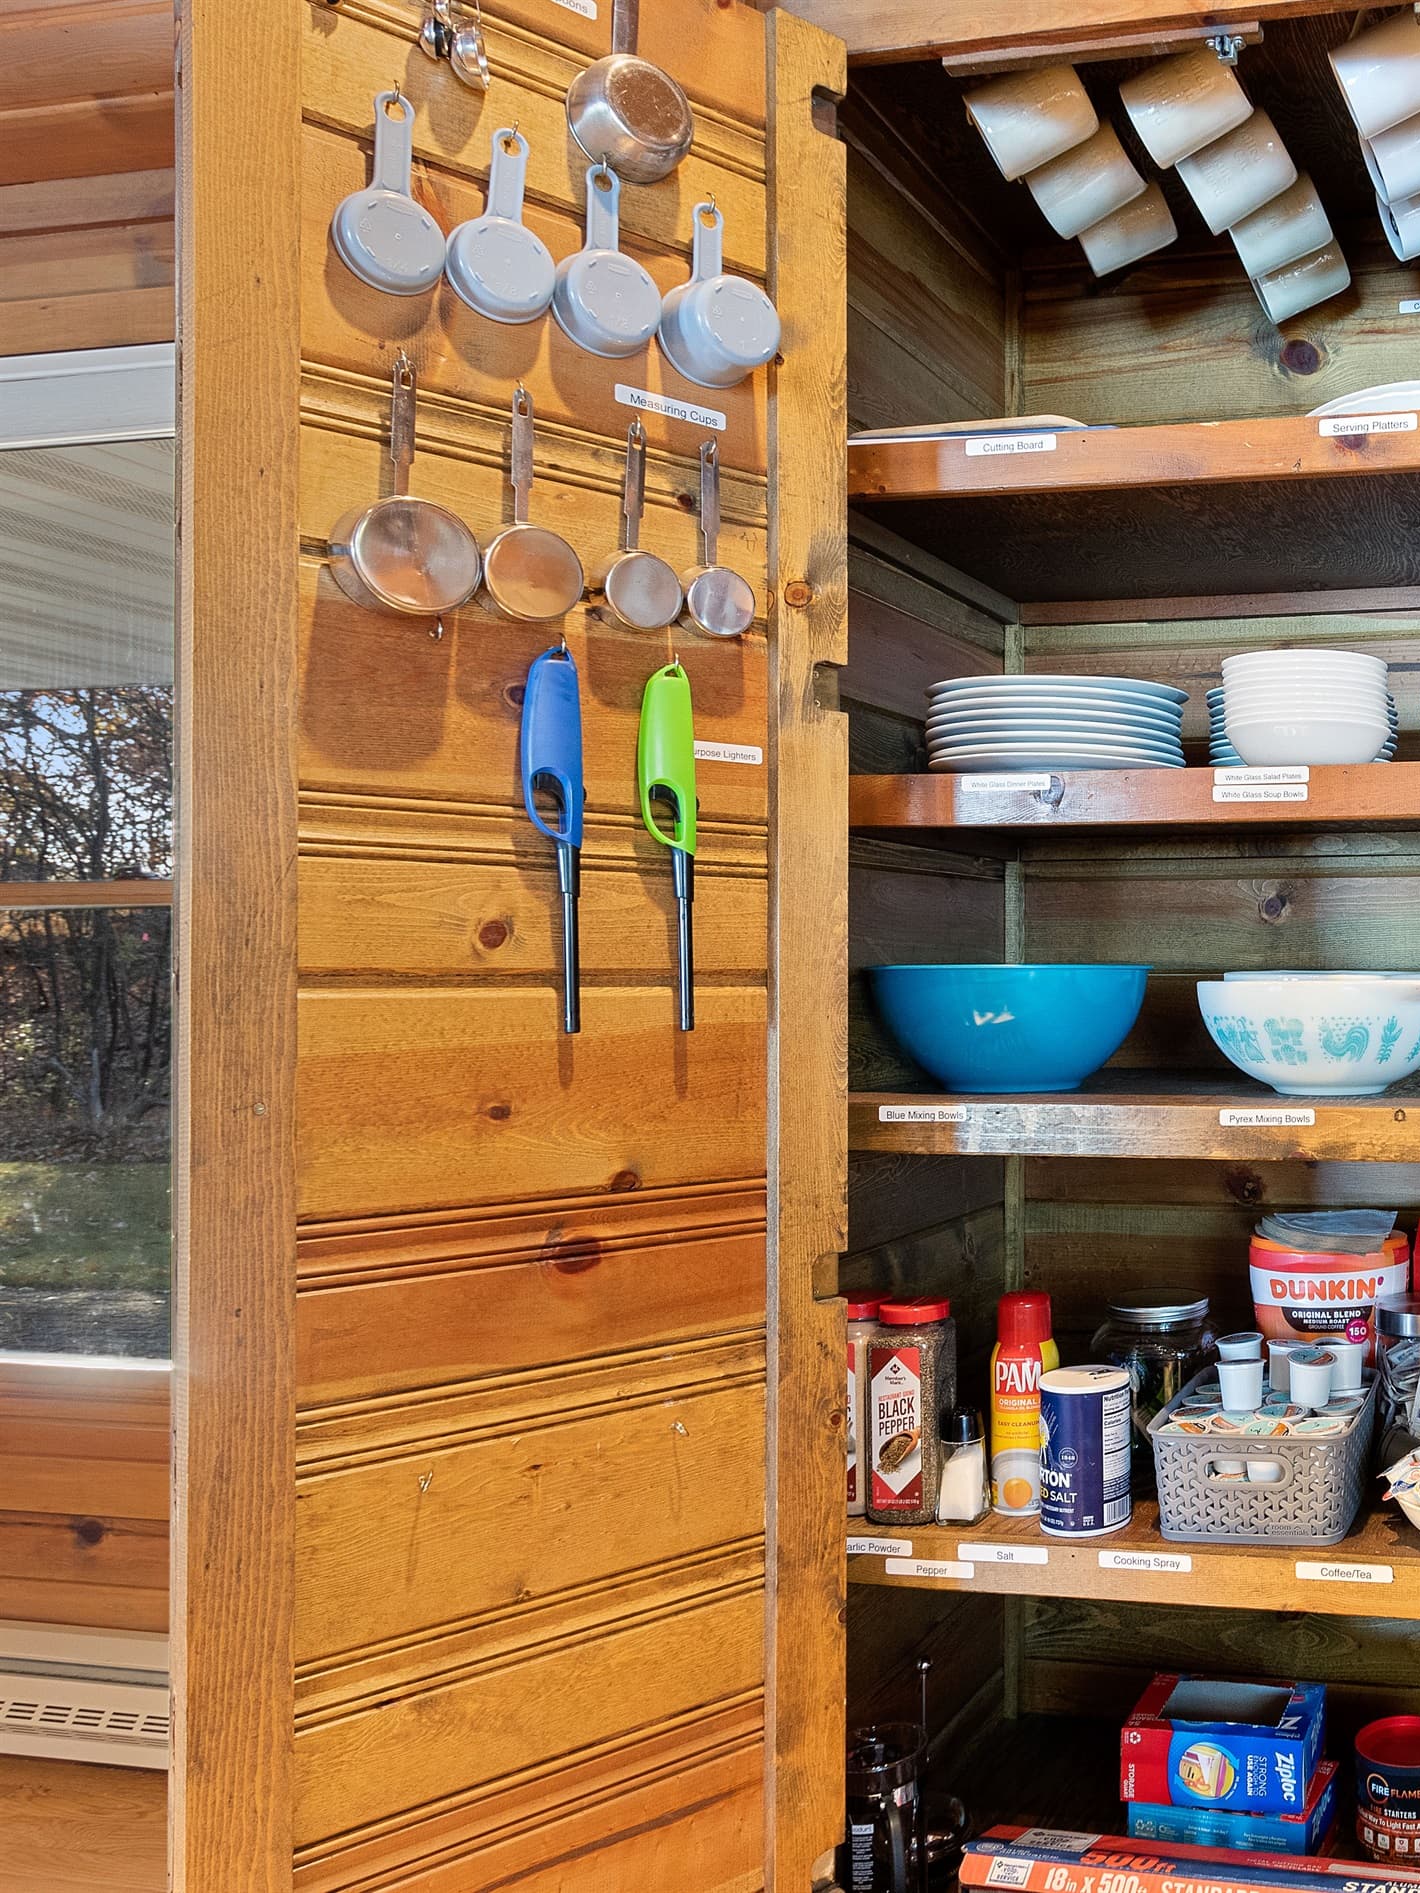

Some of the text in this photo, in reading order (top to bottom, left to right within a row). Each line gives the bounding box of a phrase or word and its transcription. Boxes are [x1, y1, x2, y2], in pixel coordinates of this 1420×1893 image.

[630, 393, 718, 427] Measuring Cups
[1332, 418, 1410, 436] Serving Platters
[982, 439, 1045, 455] Cutting Board
[723, 750, 757, 761] Lighters
[1244, 773, 1262, 781] Glass
[1221, 790, 1304, 799] White Glass Soup Bowls
[887, 1110, 964, 1123] Blue Mixing Bowls
[1229, 1114, 1311, 1127] Pyrex Mixing Bowls
[1269, 1275, 1384, 1302] DUNKIN'
[1292, 1309, 1361, 1319] ORIGINAL BLEND
[1350, 1326, 1367, 1336] 150
[995, 1360, 1042, 1393] PAM
[878, 1396, 915, 1420] BLACK
[999, 1398, 1038, 1407] ORIGINAL
[878, 1415, 916, 1437] PEPPER
[1040, 1467, 1070, 1489] RTON
[1050, 1490, 1078, 1504] SALT
[847, 1542, 901, 1554] arlic Powder
[996, 1551, 1014, 1561] Salt
[1113, 1555, 1181, 1570] Cooking Spray
[916, 1564, 948, 1577] Pepper
[1320, 1567, 1373, 1580] Coffee/Tea
[1128, 1763, 1136, 1799] STORAGE
[1246, 1770, 1254, 1796] AGAIN
[1258, 1755, 1267, 1797] STRONG
[1275, 1751, 1297, 1803] Ziploc
[1371, 1783, 1390, 1797] FIRE
[1384, 1808, 1417, 1820] STARTERS
[1379, 1818, 1386, 1827] To
[1386, 1820, 1402, 1831] Light
[1402, 1822, 1416, 1831] Fast
